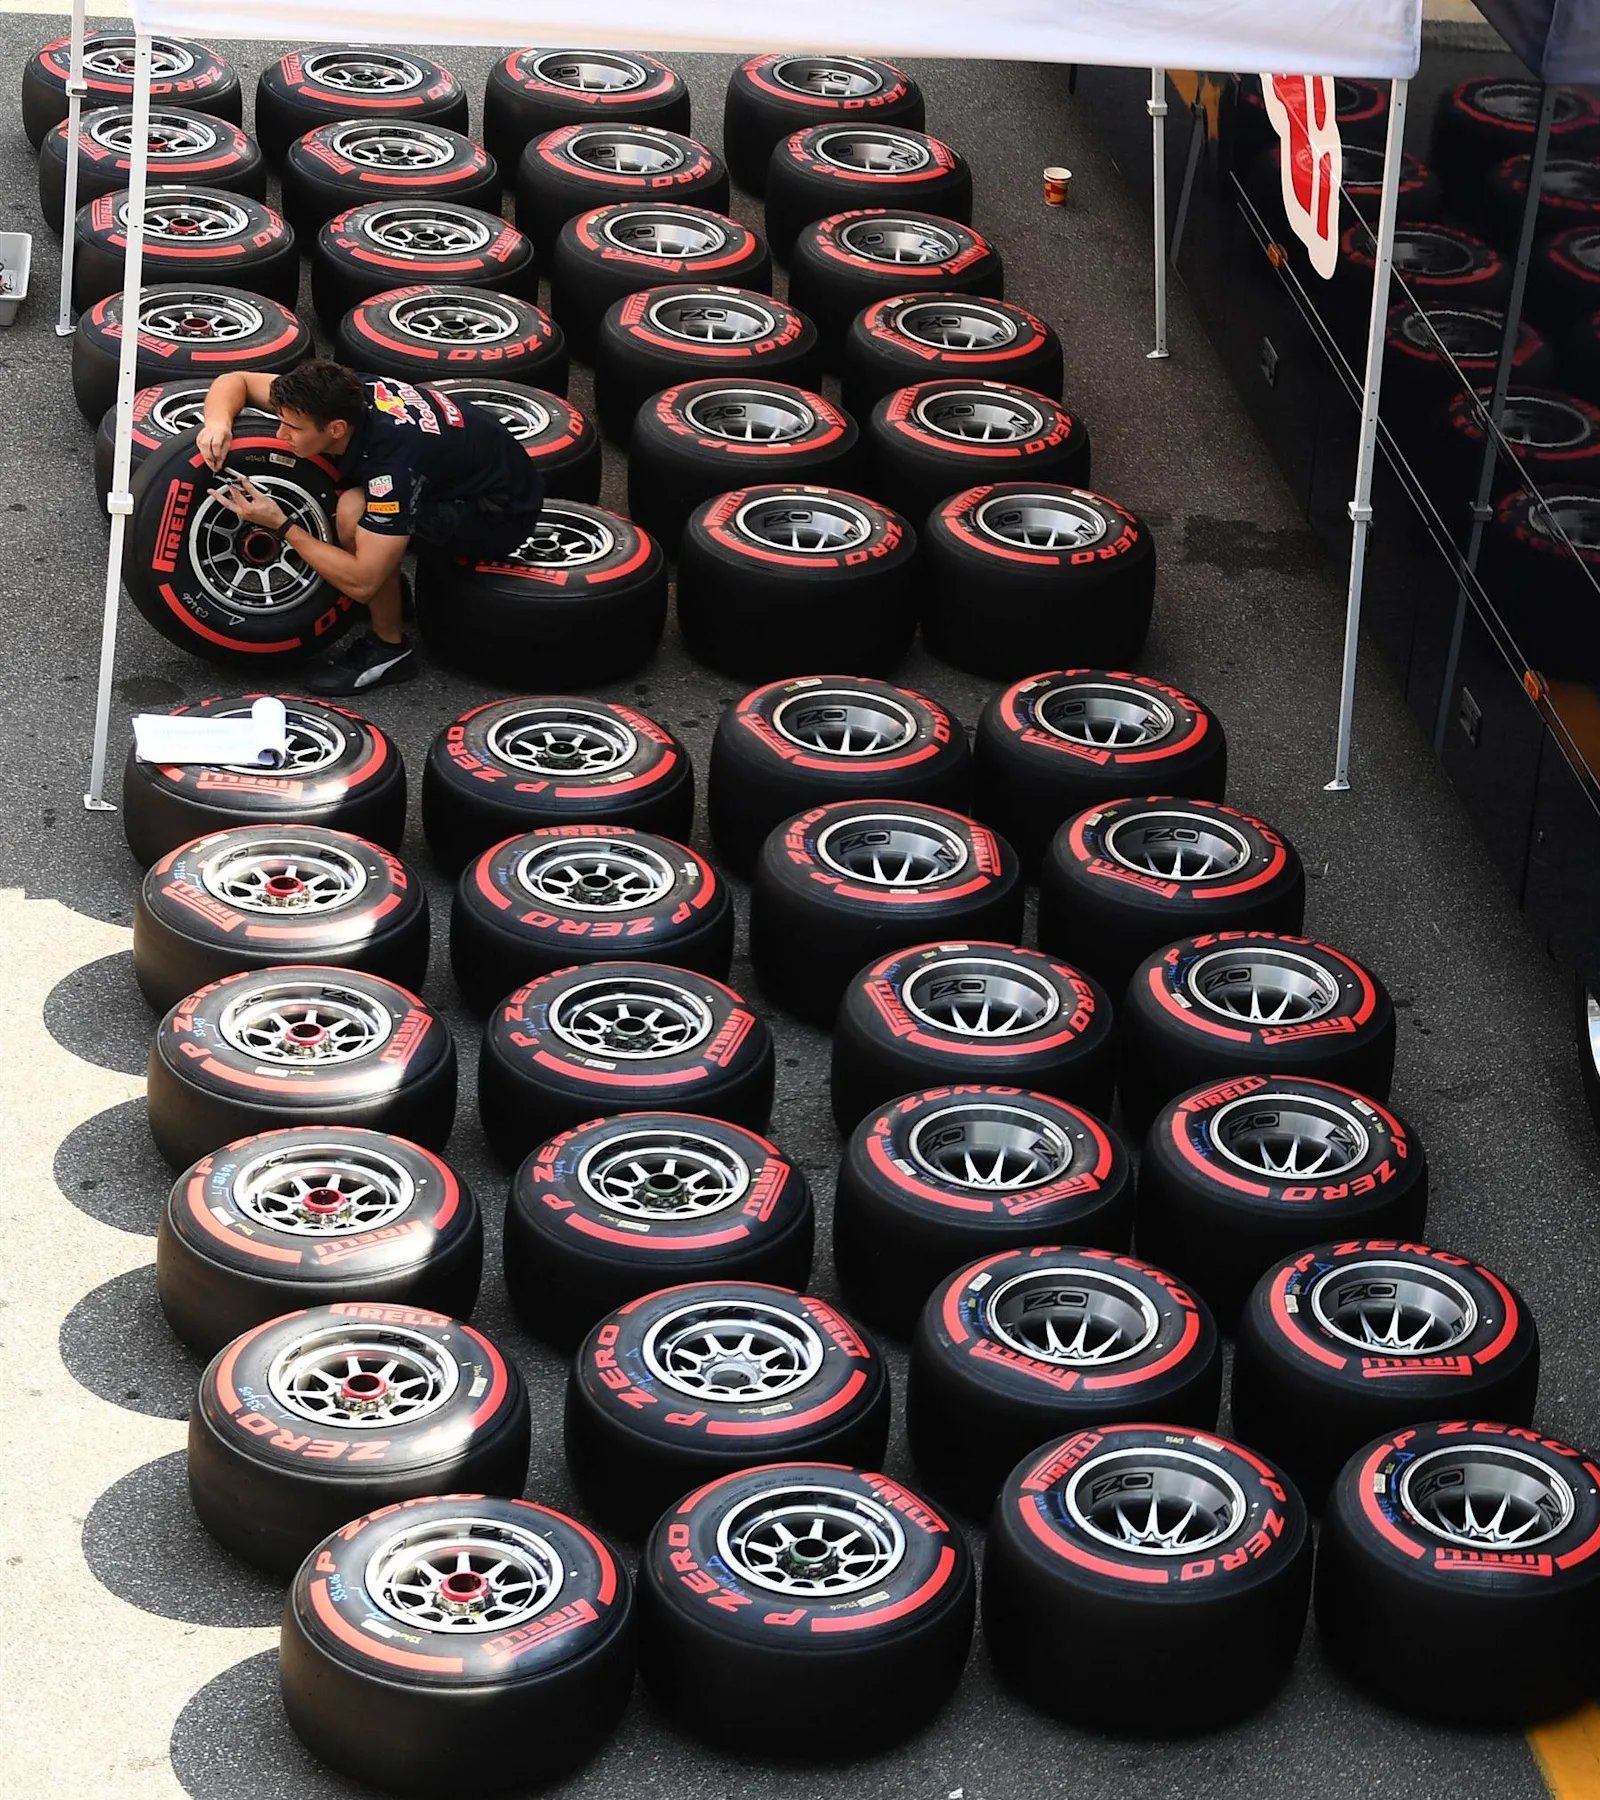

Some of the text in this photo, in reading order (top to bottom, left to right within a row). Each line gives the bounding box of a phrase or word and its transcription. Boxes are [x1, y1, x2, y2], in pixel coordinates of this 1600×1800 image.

[150, 66, 222, 94] ZERO
[843, 83, 907, 109] ZERO
[787, 128, 813, 161] ZERO
[652, 156, 712, 188] ZERO
[620, 293, 650, 325] PIRELLI
[448, 334, 543, 360] ZERO
[755, 314, 803, 354] ZERO
[656, 390, 696, 436] ZERO
[800, 391, 848, 427] PIRELLI
[886, 386, 920, 421] PIRELLI
[1025, 411, 1072, 455] ZERO
[703, 491, 748, 526] PIRELLI
[941, 485, 994, 517] PIRELLI
[152, 478, 195, 573] PIRELLI
[845, 520, 903, 566] ZERO
[1071, 524, 1139, 565] ZERO
[607, 703, 676, 746] PIRELLI
[739, 713, 801, 760] PIRELLI
[446, 726, 549, 793] P ZERO
[196, 771, 303, 799] PIRELLI
[532, 824, 637, 837] PIRELLI
[785, 807, 827, 866] ZERO
[968, 825, 1002, 877] PIRELLI
[1087, 858, 1182, 900] PIRELLI
[161, 879, 246, 933] PIRELLI
[519, 901, 694, 937] P ZERO
[1191, 930, 1312, 949] ZERO
[172, 971, 249, 1059] P ZERO
[504, 965, 579, 1048] P ZERO
[864, 979, 918, 1038] PIRELLI
[1049, 963, 1096, 1034] ZERO
[380, 1009, 434, 1065] PIRELLI
[703, 1008, 755, 1068] PIRELLI
[1260, 1016, 1356, 1046] PIRELLI
[873, 1083, 1023, 1136] P ZERO
[1177, 1076, 1268, 1113] PIRELLI
[532, 1117, 606, 1211] P ZERO
[1281, 1159, 1396, 1201] ZERO
[743, 1158, 791, 1223] PIRELLI
[1000, 1172, 1100, 1216] PIRELLI
[1294, 1240, 1470, 1272] P ZERO
[329, 1302, 452, 1327] PIRELLI
[799, 1297, 870, 1358] PIRELLI
[595, 1324, 707, 1426] P ZERO
[970, 1338, 1080, 1391] PIRELLI
[1362, 1354, 1472, 1379] PIRELLI
[237, 1413, 391, 1461] ZERO
[1392, 1421, 1581, 1457] P ZERO
[1020, 1432, 1104, 1492] PIRELLI
[859, 1473, 949, 1534] PIRELLI
[316, 1493, 486, 1573] P ZERO
[1180, 1476, 1287, 1581] P ZERO
[668, 1523, 808, 1626] P ZERO
[1434, 1547, 1553, 1577] PIRELLI
[481, 1598, 600, 1664] PIRELLI
